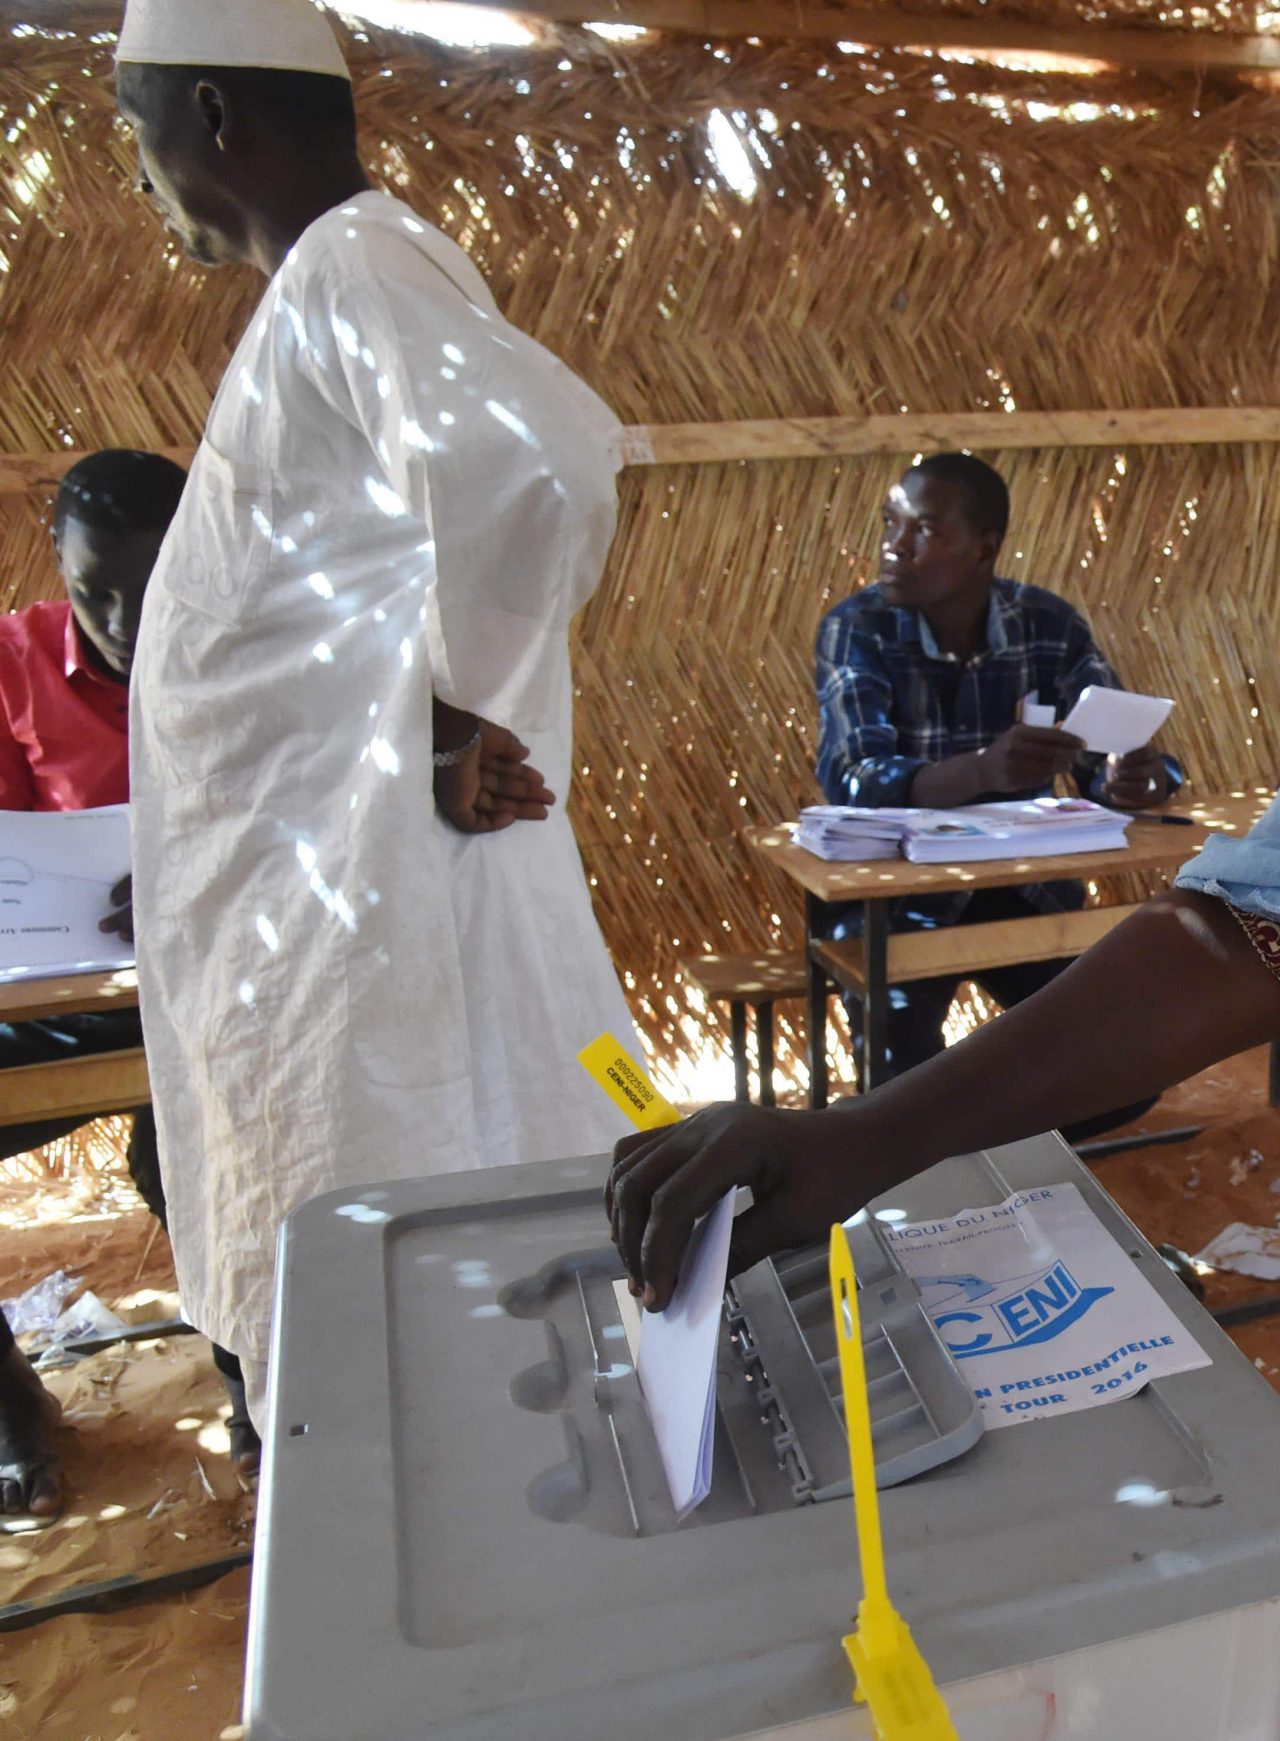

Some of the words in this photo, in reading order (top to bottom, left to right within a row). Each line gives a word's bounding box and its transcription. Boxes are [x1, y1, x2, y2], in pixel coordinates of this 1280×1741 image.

[606, 1067, 646, 1112] CENI-NIGER
[614, 1058, 655, 1103] 000225090
[956, 1214, 986, 1228] DU
[1000, 1335, 1175, 1394] PRESIDENTIELLE
[1001, 1393, 1067, 1414] TOUR
[1091, 1361, 1149, 1395] 2016
